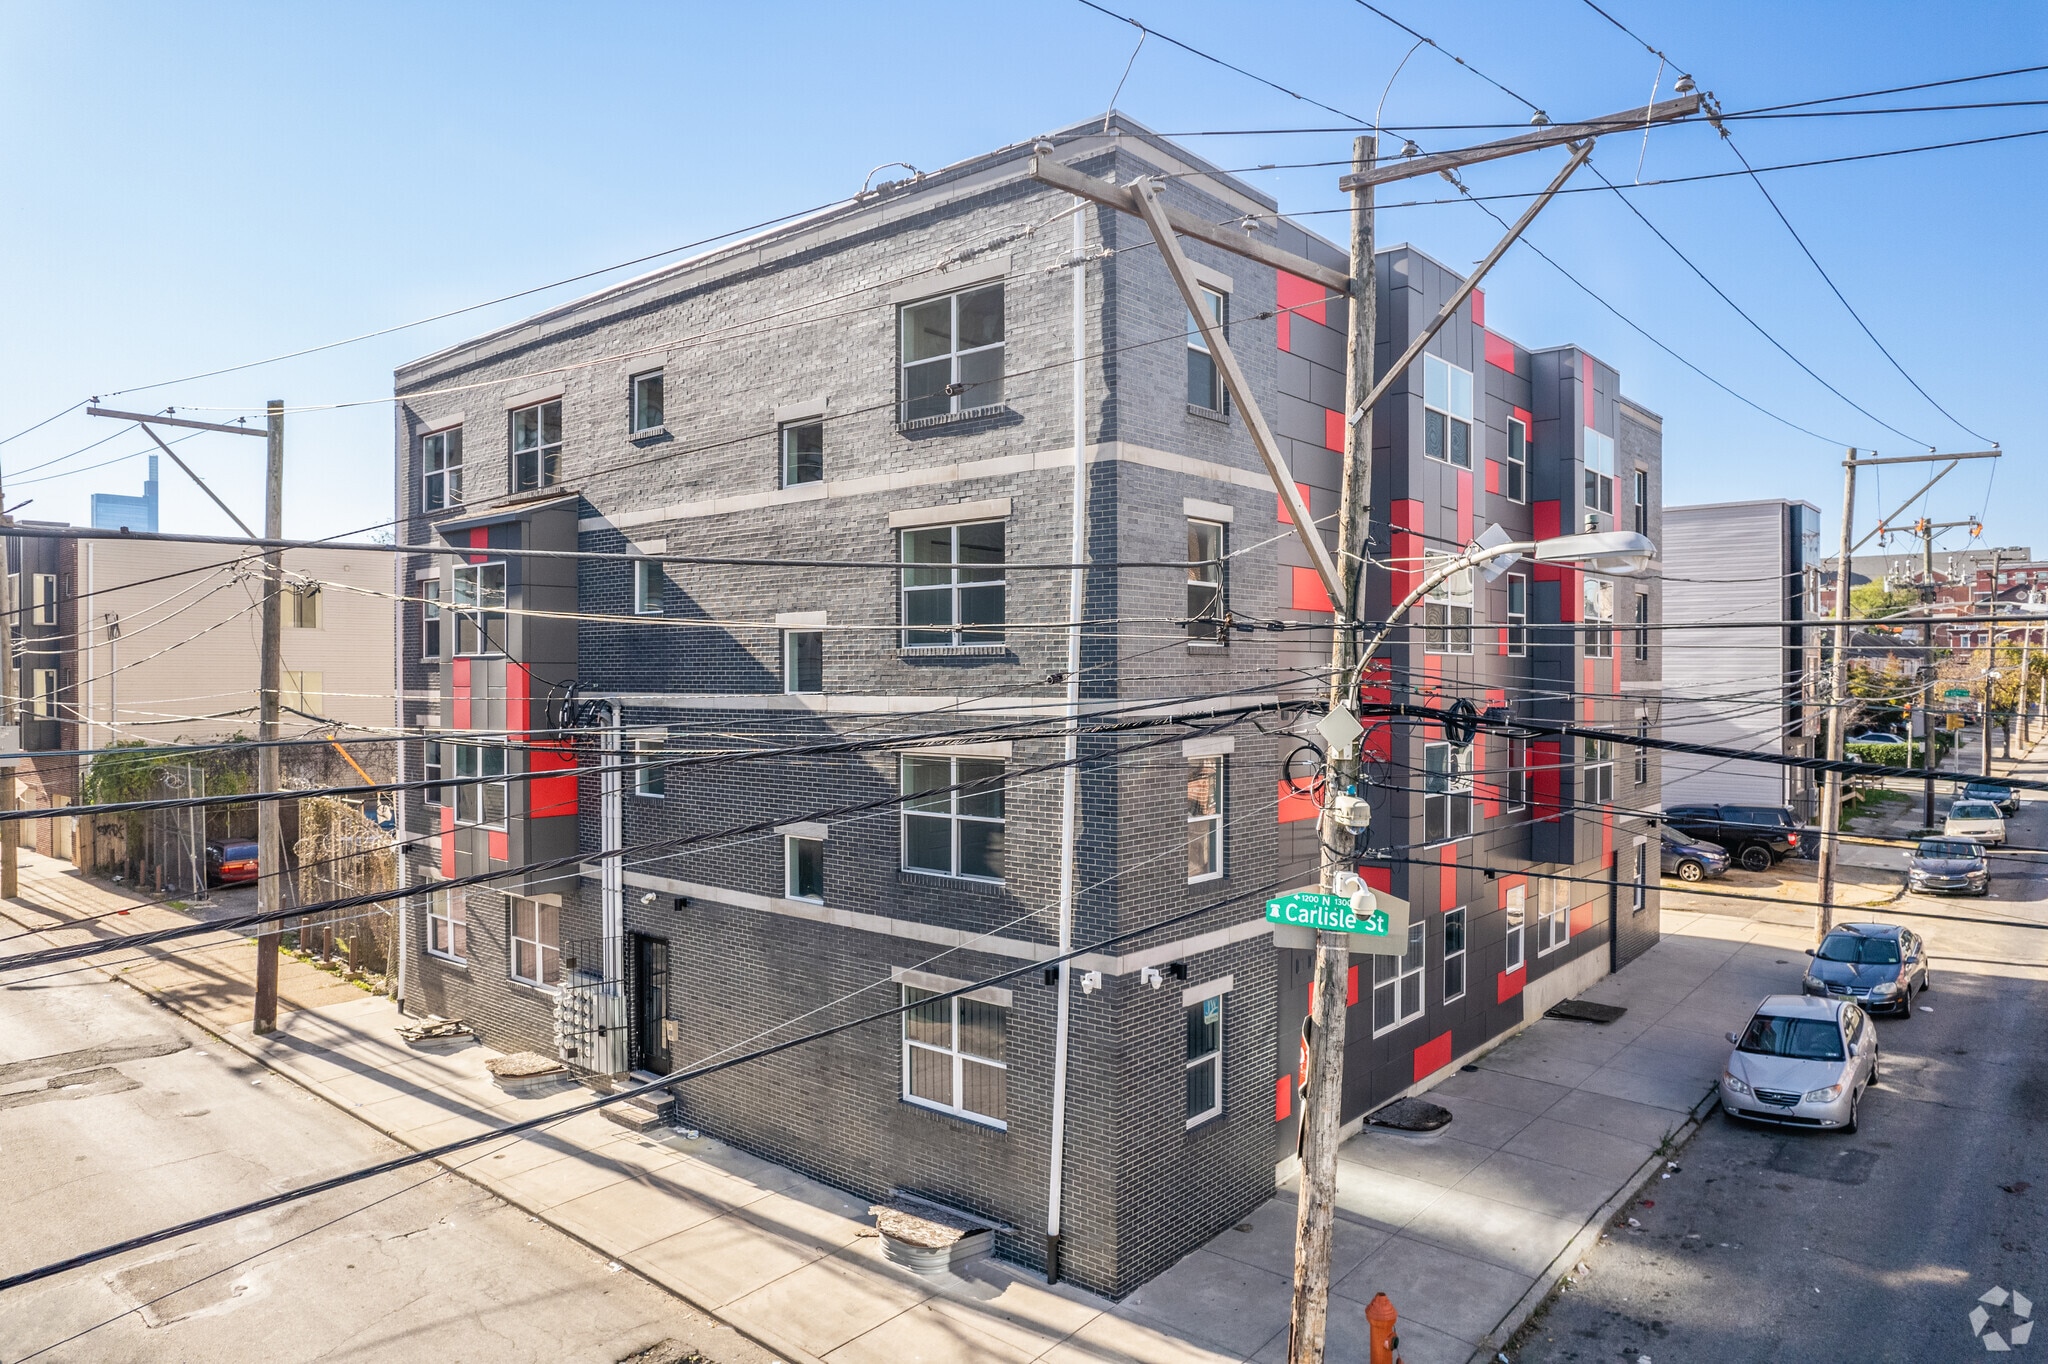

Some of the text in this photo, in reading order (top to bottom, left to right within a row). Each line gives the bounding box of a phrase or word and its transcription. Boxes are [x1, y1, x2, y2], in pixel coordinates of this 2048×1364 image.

[1302, 895, 1351, 907] 1200 N 1300
[1285, 903, 1385, 933] Carlisle St
